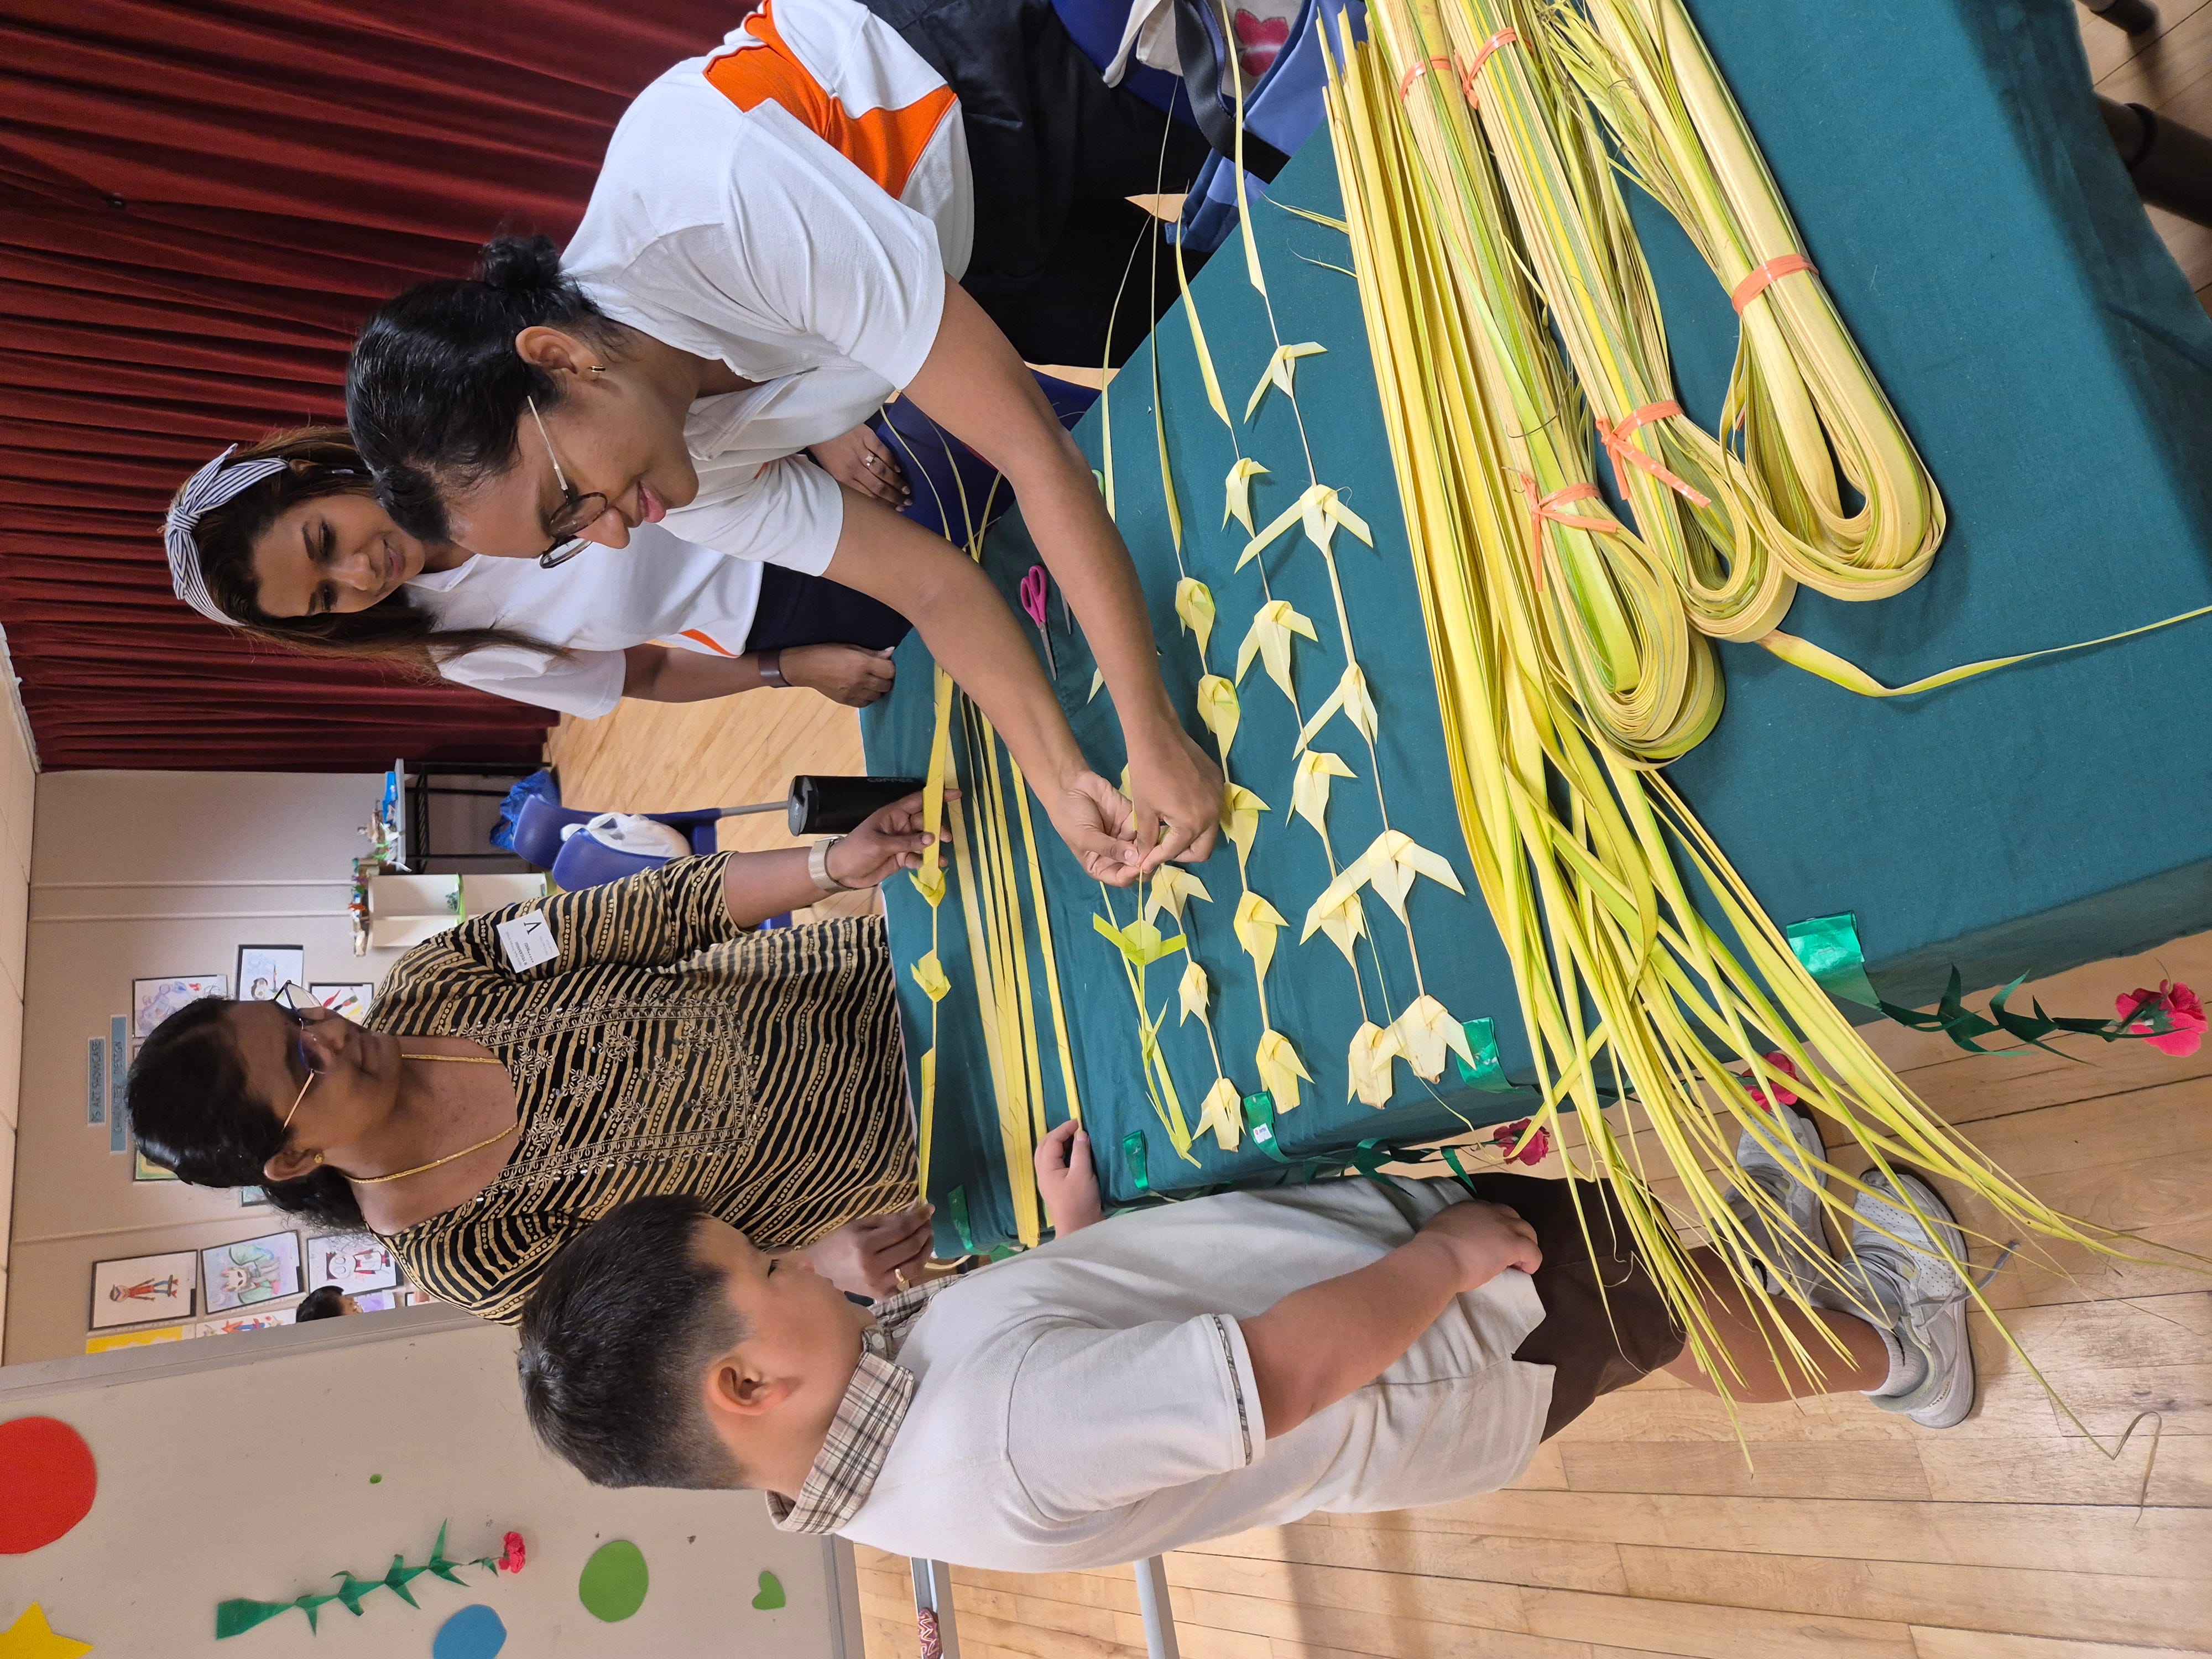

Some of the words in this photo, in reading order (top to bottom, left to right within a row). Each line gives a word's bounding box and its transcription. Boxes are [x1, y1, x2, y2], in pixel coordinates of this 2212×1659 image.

[523, 921, 542, 935] V
[91, 1040, 101, 1088] SHOWCASE
[113, 1041, 123, 1074] DESIGN
